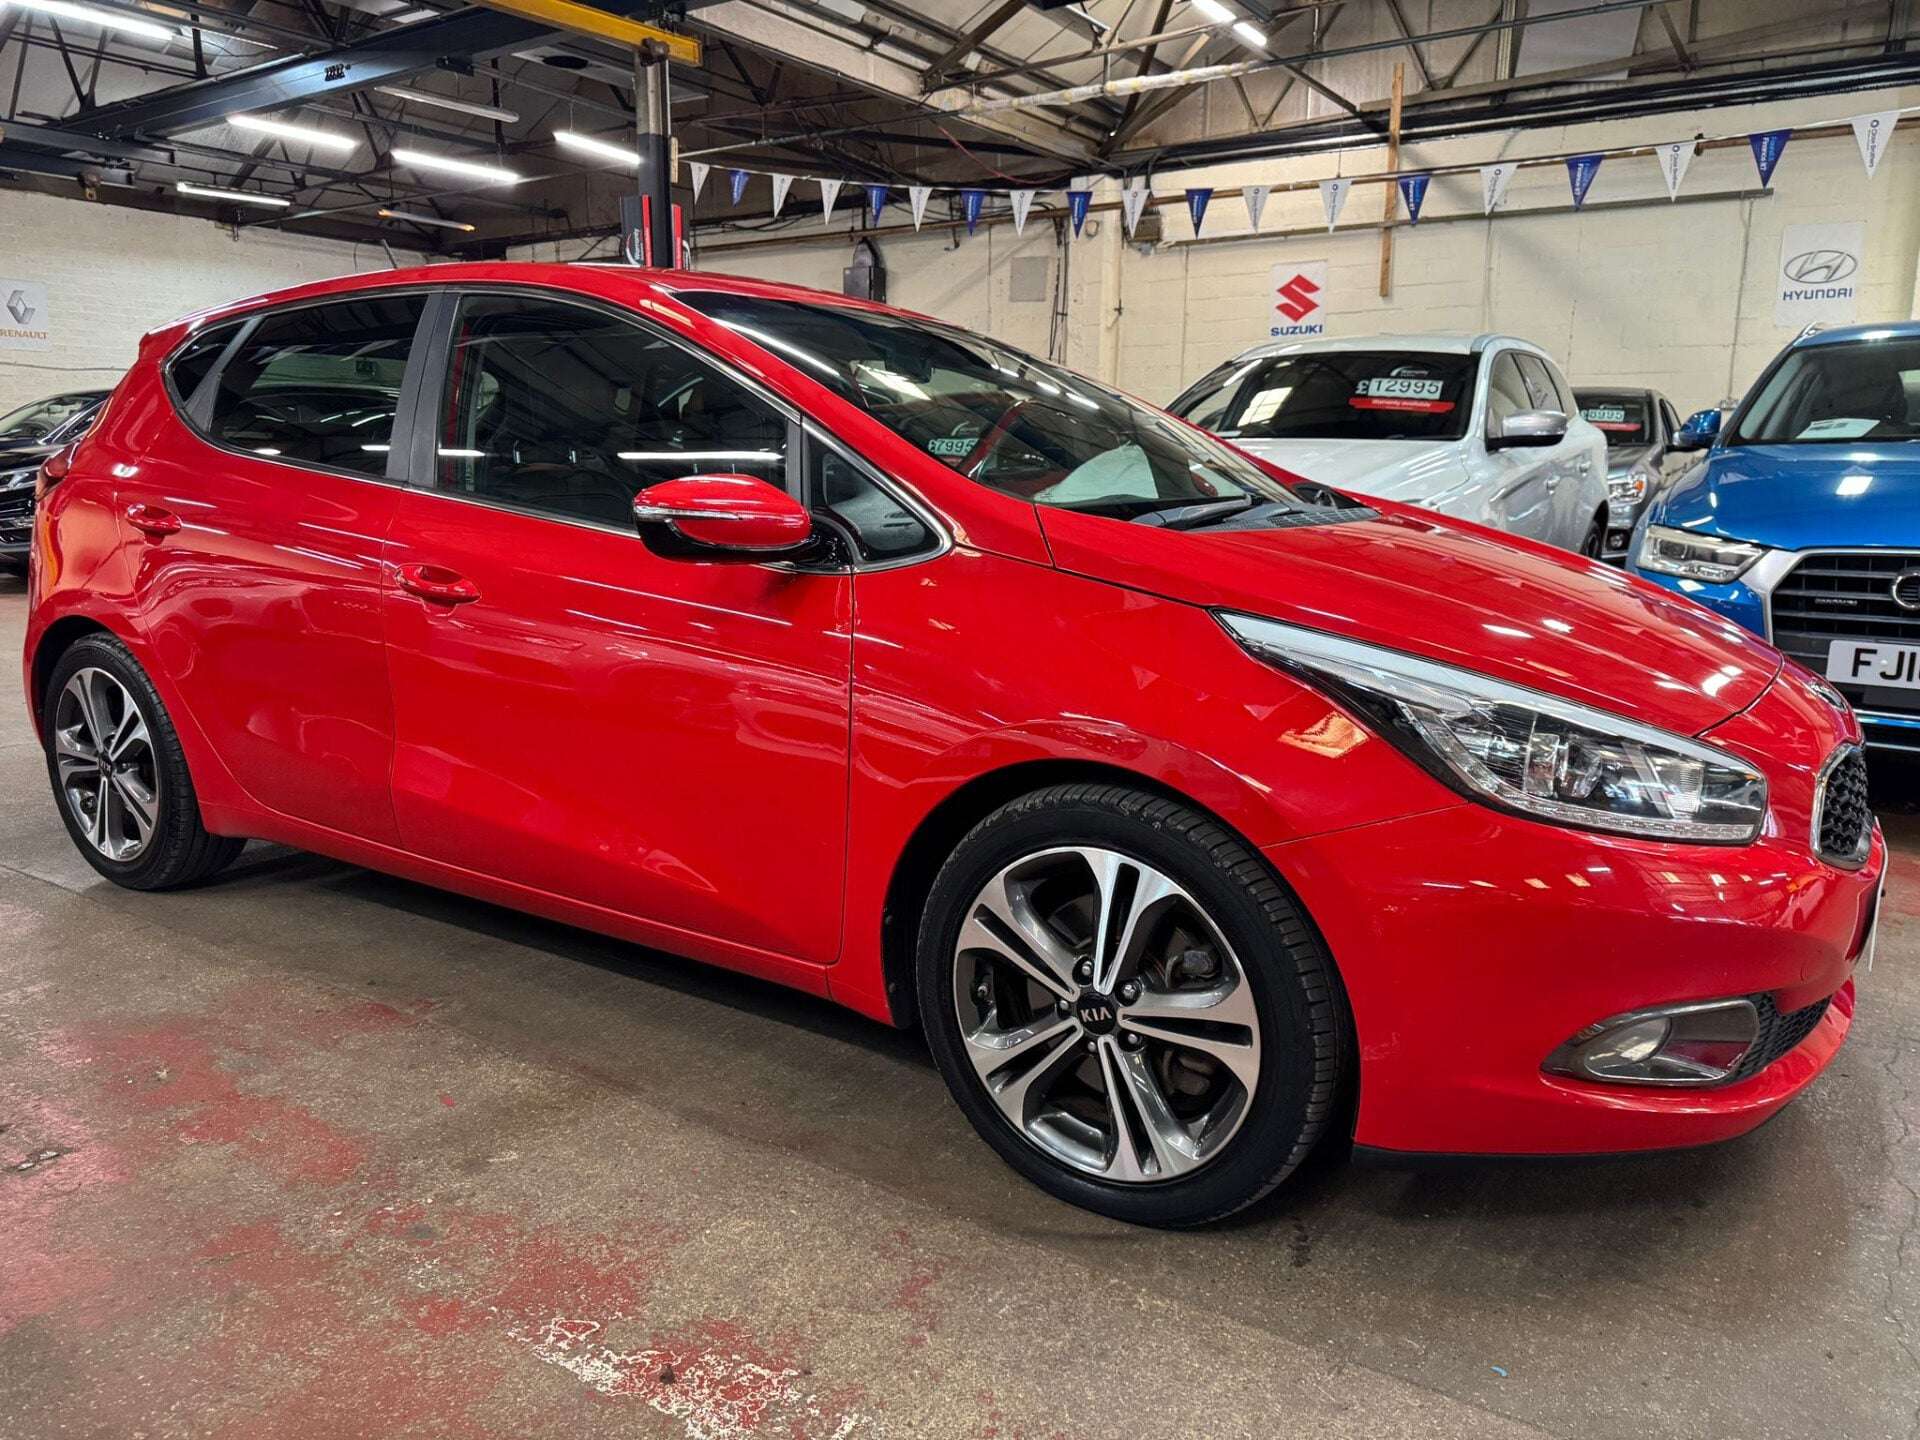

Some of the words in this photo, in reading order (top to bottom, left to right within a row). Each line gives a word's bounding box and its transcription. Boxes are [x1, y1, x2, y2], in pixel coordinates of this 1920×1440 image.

[1782, 287, 1853, 301] HYUNDAI
[0, 328, 48, 340] RENAULT
[1270, 323, 1323, 337] SUZUKI
[1851, 647, 1920, 682] FJ1
[1080, 1006, 1113, 1022] KIA
